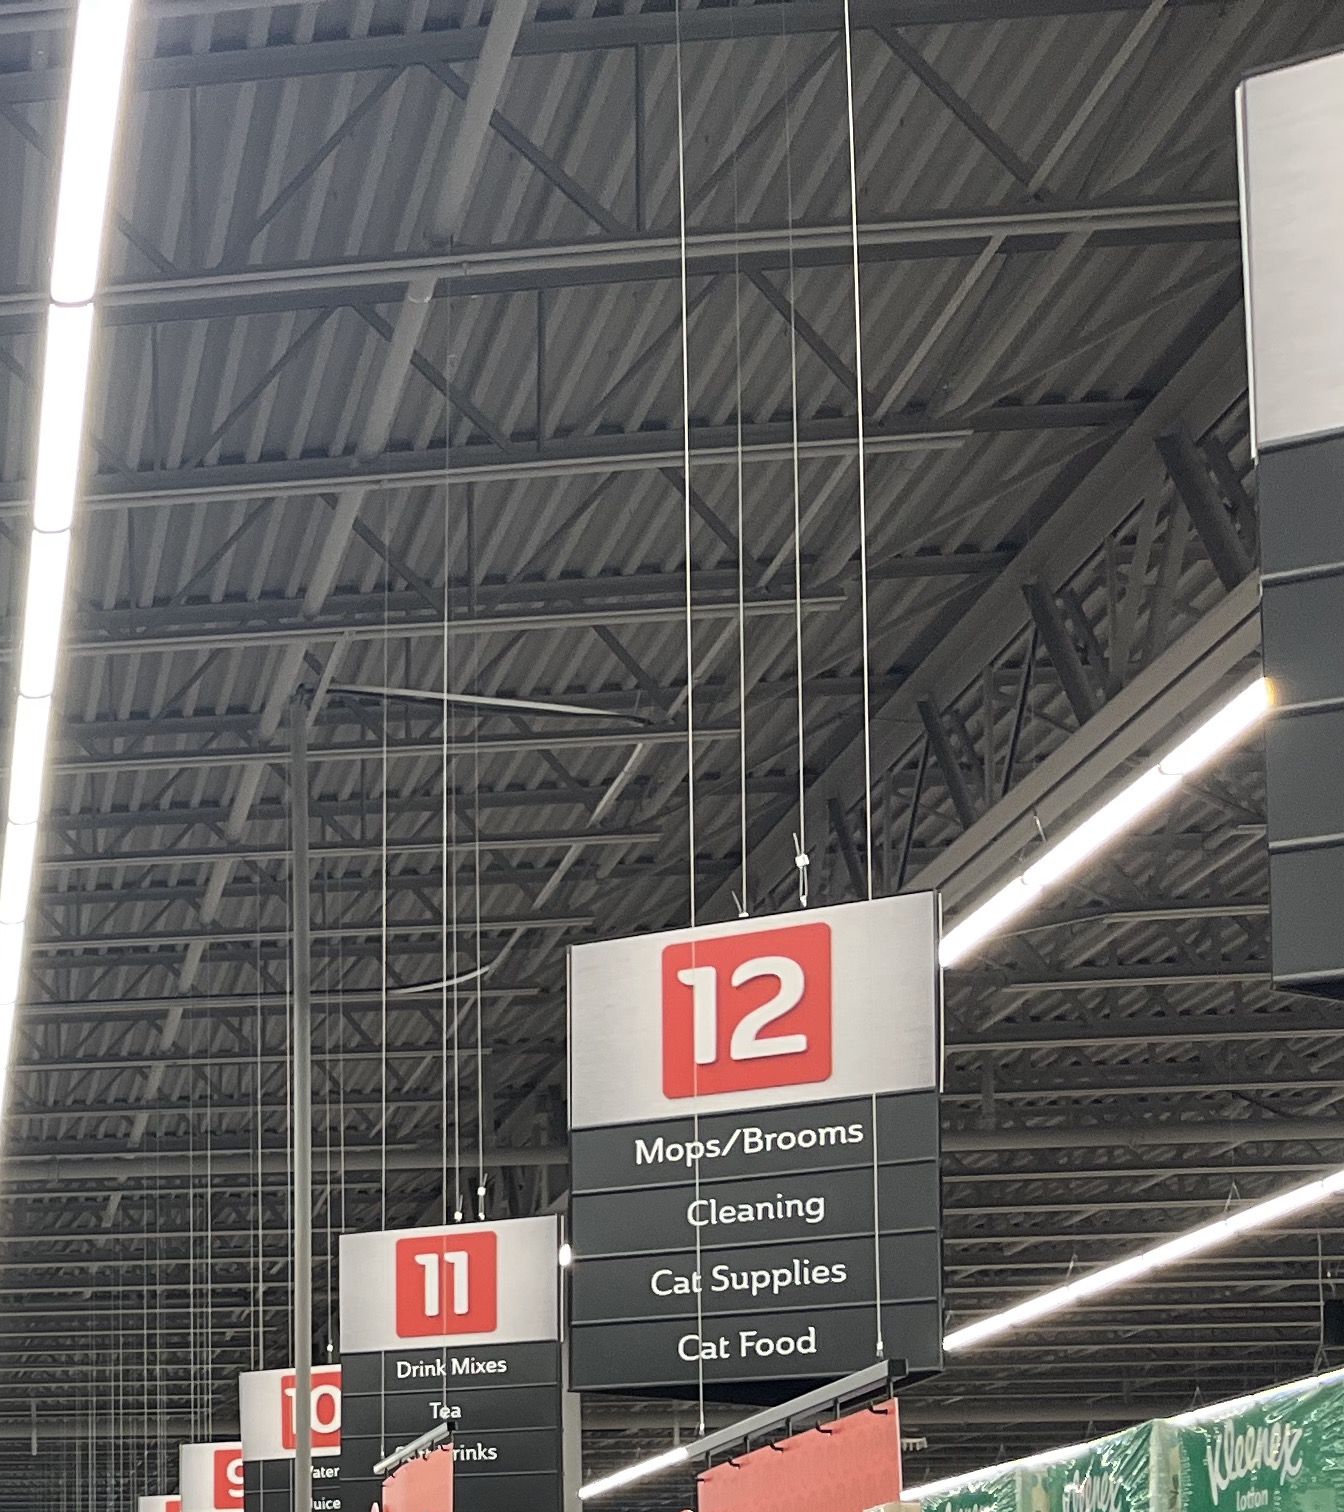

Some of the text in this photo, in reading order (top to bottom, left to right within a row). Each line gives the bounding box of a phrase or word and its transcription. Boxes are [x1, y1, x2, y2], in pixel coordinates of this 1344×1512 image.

[677, 955, 808, 1064] 12
[635, 1122, 864, 1165] Mops/Brooms
[687, 1193, 826, 1227] Cleaning
[414, 1250, 469, 1317] 11
[651, 1259, 847, 1296] Cat Supplies
[678, 1327, 817, 1361] Cat Food
[396, 1358, 507, 1379] Drink Mixes
[429, 1402, 462, 1419] Tea
[453, 1443, 498, 1461] rinks
[1210, 1418, 1303, 1505] Kleenex
[311, 1465, 340, 1479] ater
[1236, 1488, 1269, 1512] lotion
